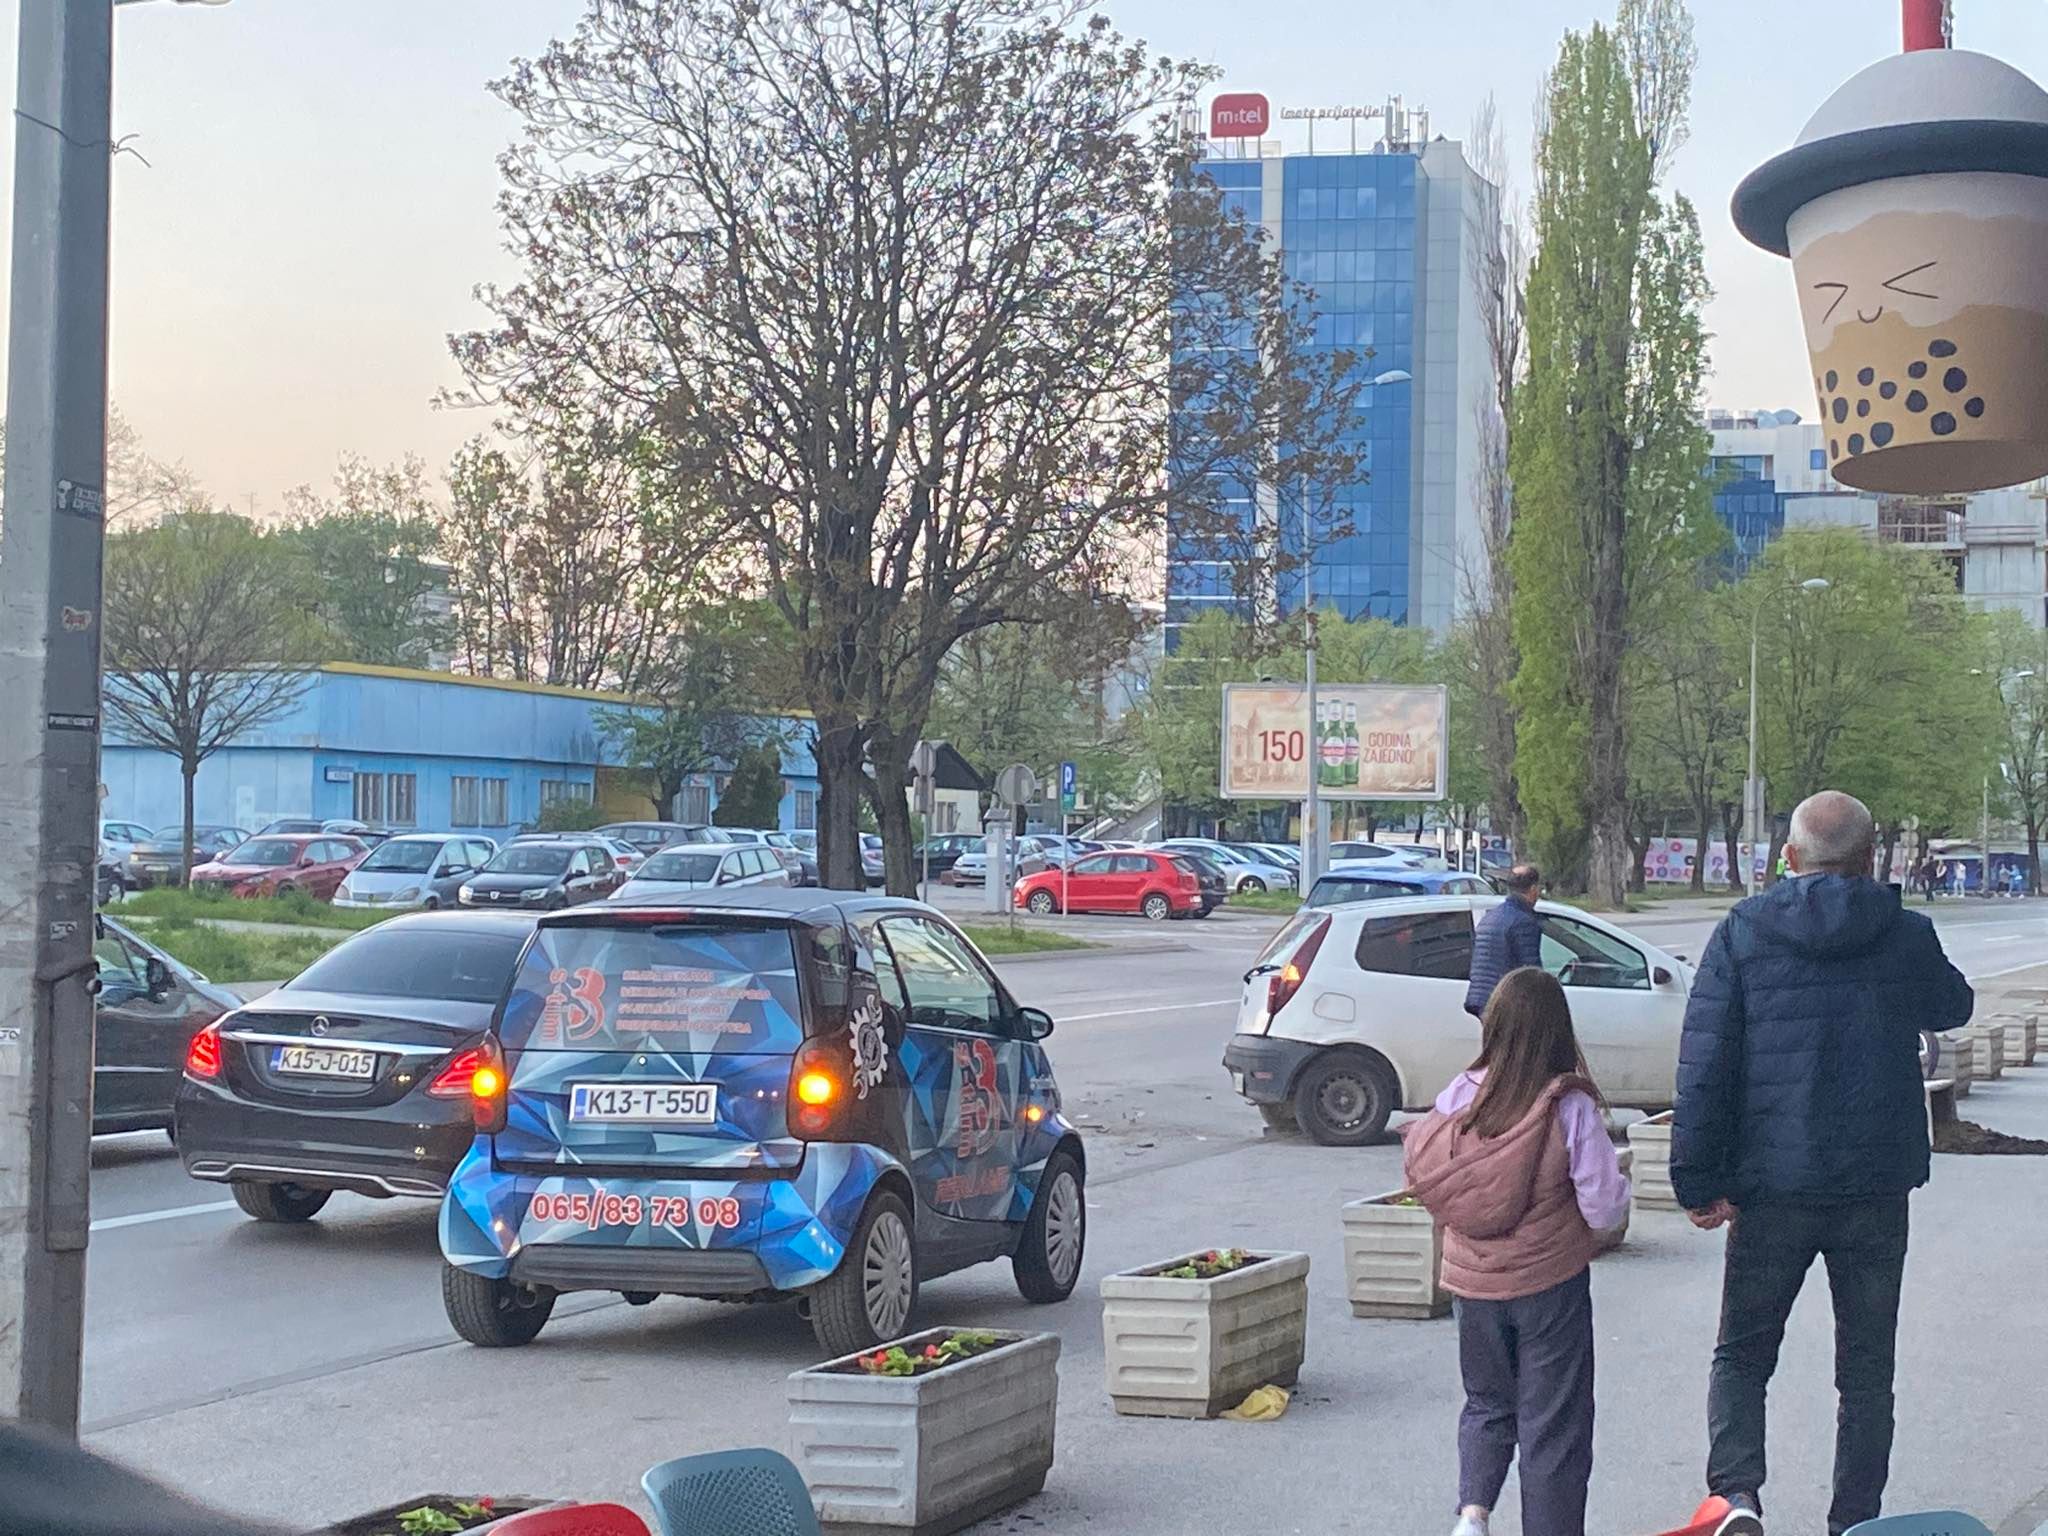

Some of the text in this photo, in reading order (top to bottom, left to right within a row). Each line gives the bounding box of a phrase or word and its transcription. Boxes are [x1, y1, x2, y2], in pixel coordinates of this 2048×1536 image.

[1258, 730, 1304, 762] 150
[1368, 732, 1411, 747] GODINA
[1064, 766, 1072, 790] P
[282, 1049, 373, 1074] K15-J-015
[588, 1088, 709, 1114] K13-T-550
[532, 1189, 740, 1230] 065/83 73 08
